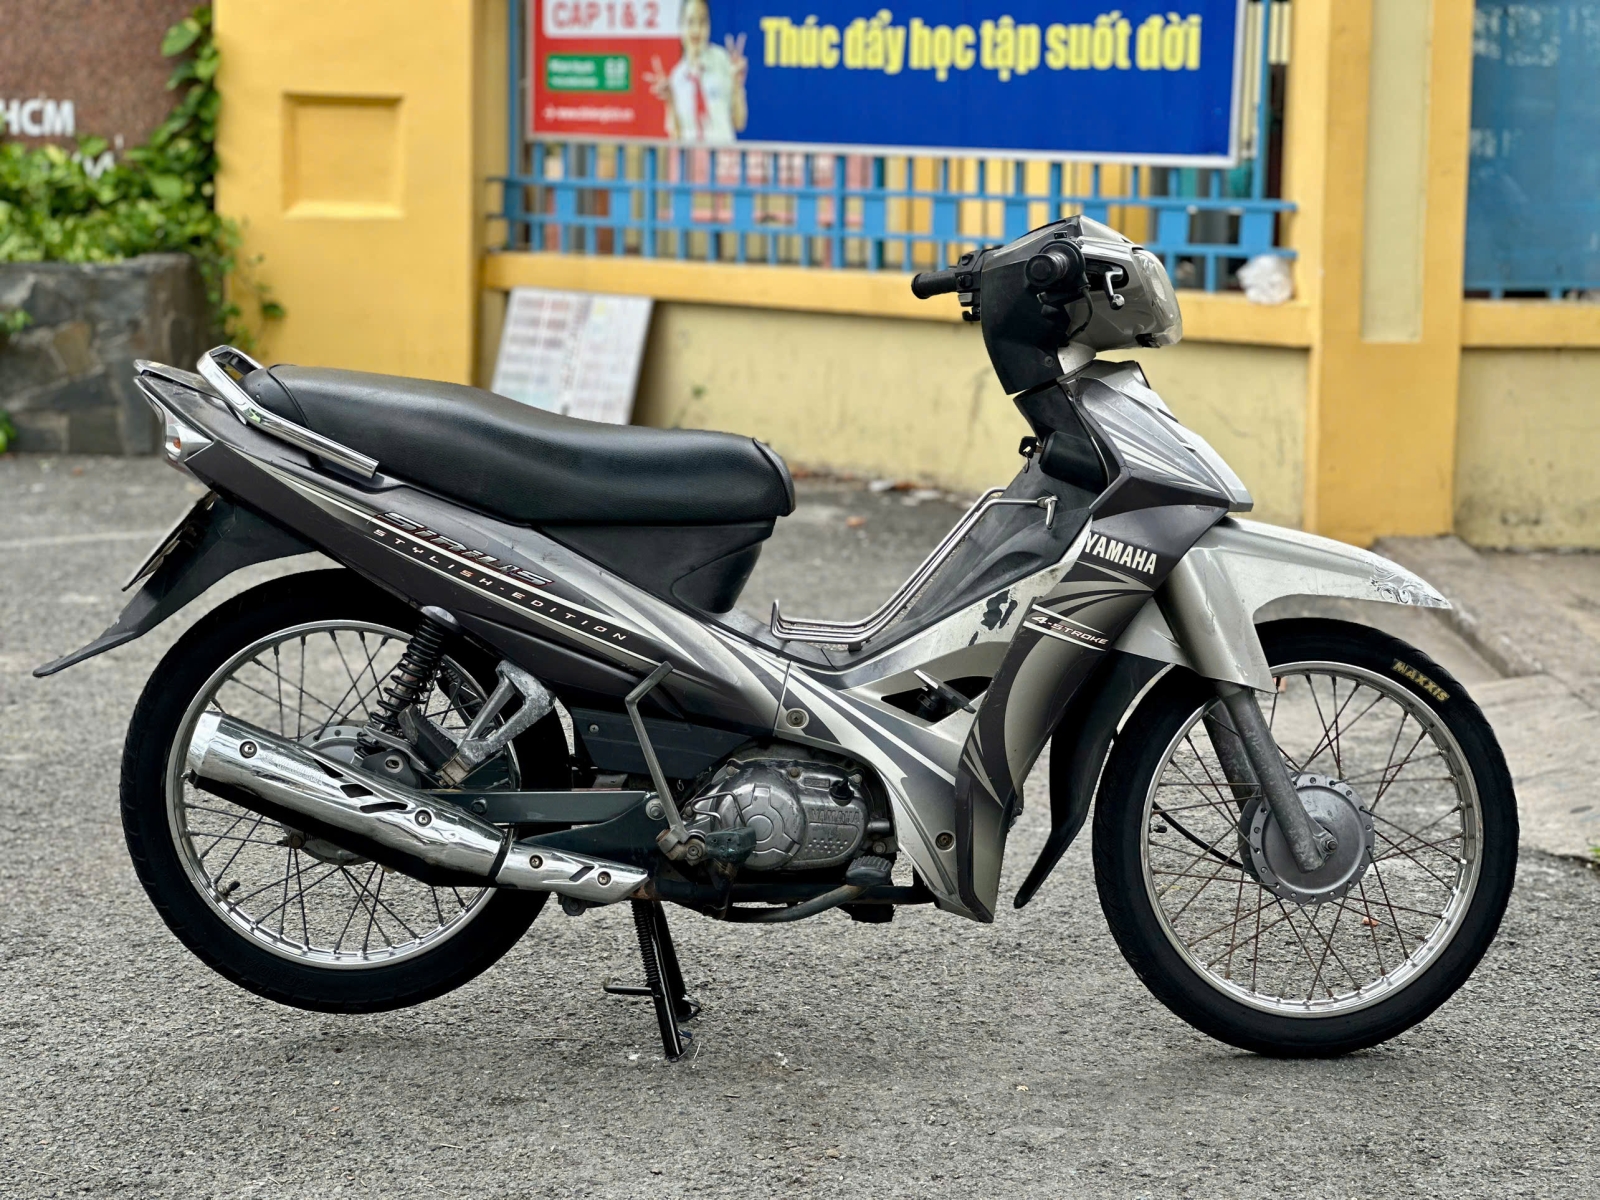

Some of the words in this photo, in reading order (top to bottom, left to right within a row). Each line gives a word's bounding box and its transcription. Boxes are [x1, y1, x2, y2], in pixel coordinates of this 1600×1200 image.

[642, 1, 660, 29] 2
[760, 14, 840, 69] Thúc
[843, 8, 907, 75] đẩy
[908, 17, 976, 82] học
[979, 14, 1041, 82] tập
[1045, 10, 1132, 70] suốt
[1136, 12, 1203, 71] đời
[1084, 531, 1158, 575] YAMAHA
[1031, 615, 1109, 645] 4-STROKE
[1392, 660, 1450, 701] MAXXIS
[811, 808, 861, 823] YAMAHA
